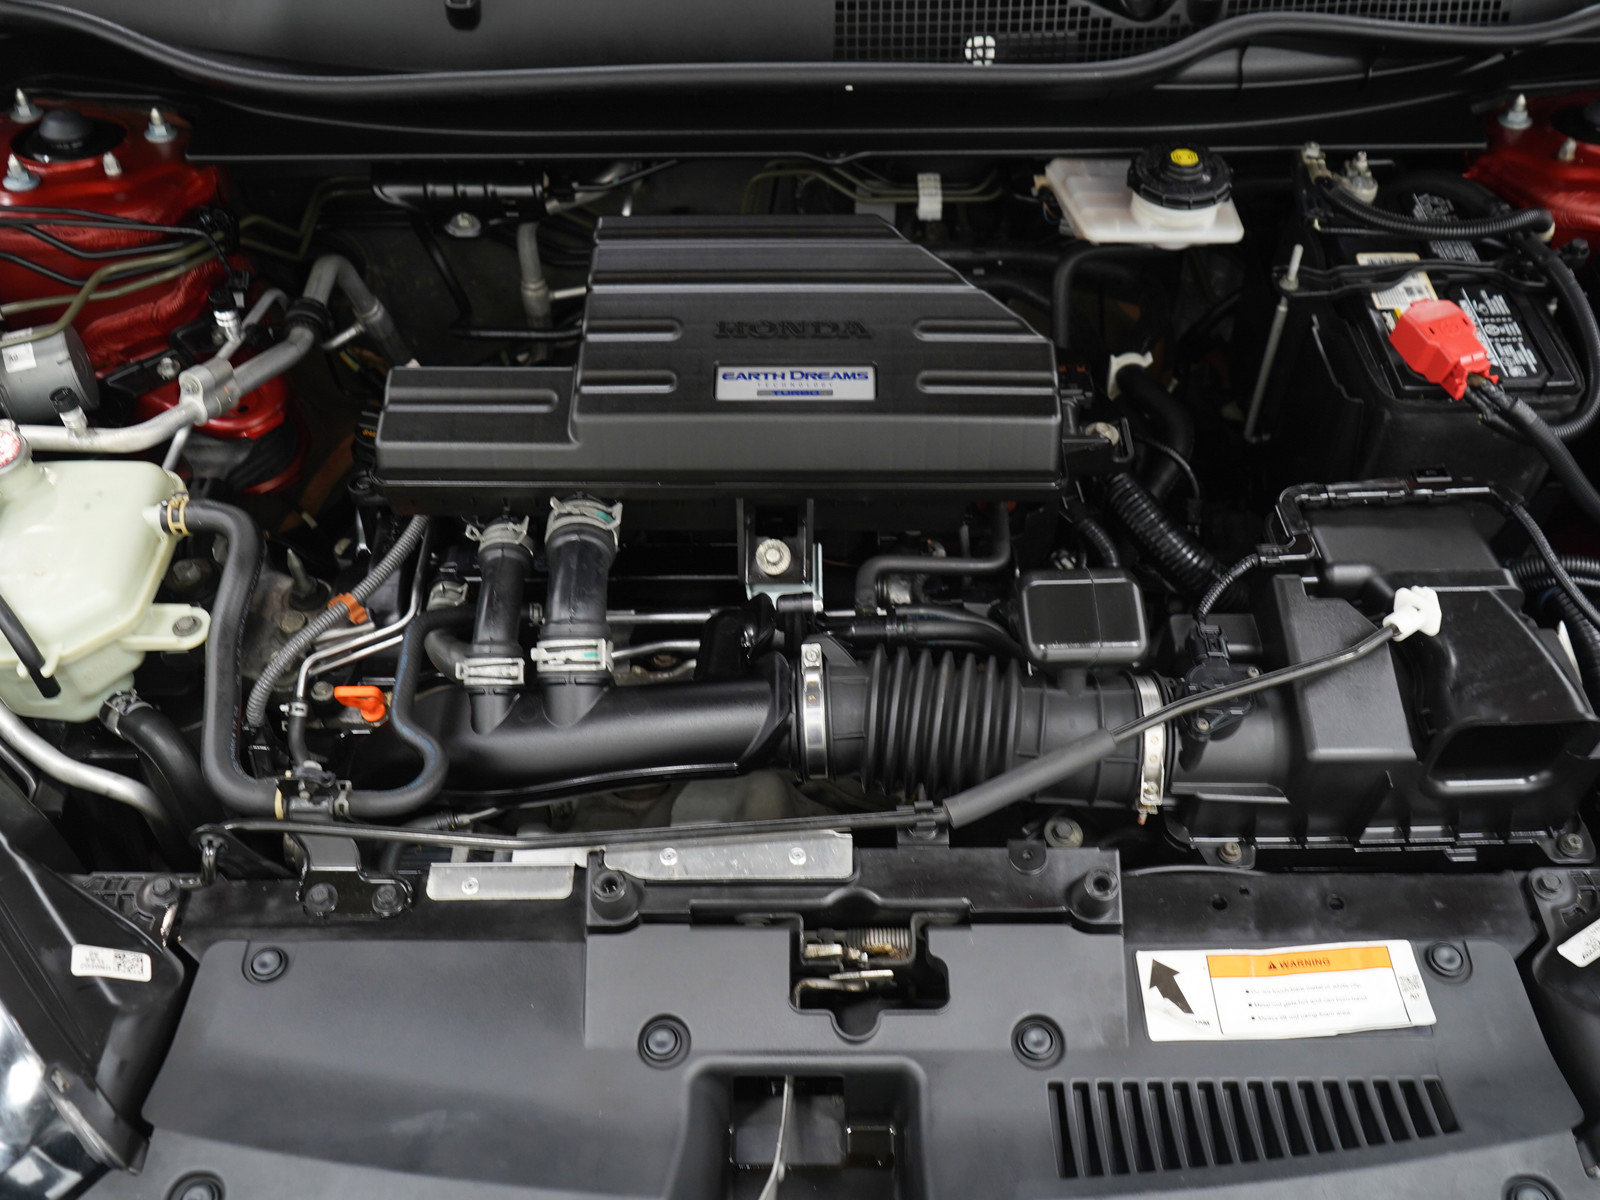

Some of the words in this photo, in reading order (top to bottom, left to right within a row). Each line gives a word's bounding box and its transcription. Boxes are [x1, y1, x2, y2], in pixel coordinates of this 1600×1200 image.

[714, 320, 873, 339] HONDA
[721, 371, 786, 381] EARTH
[790, 370, 869, 381] DREAMS
[1279, 958, 1330, 969] WARNING
